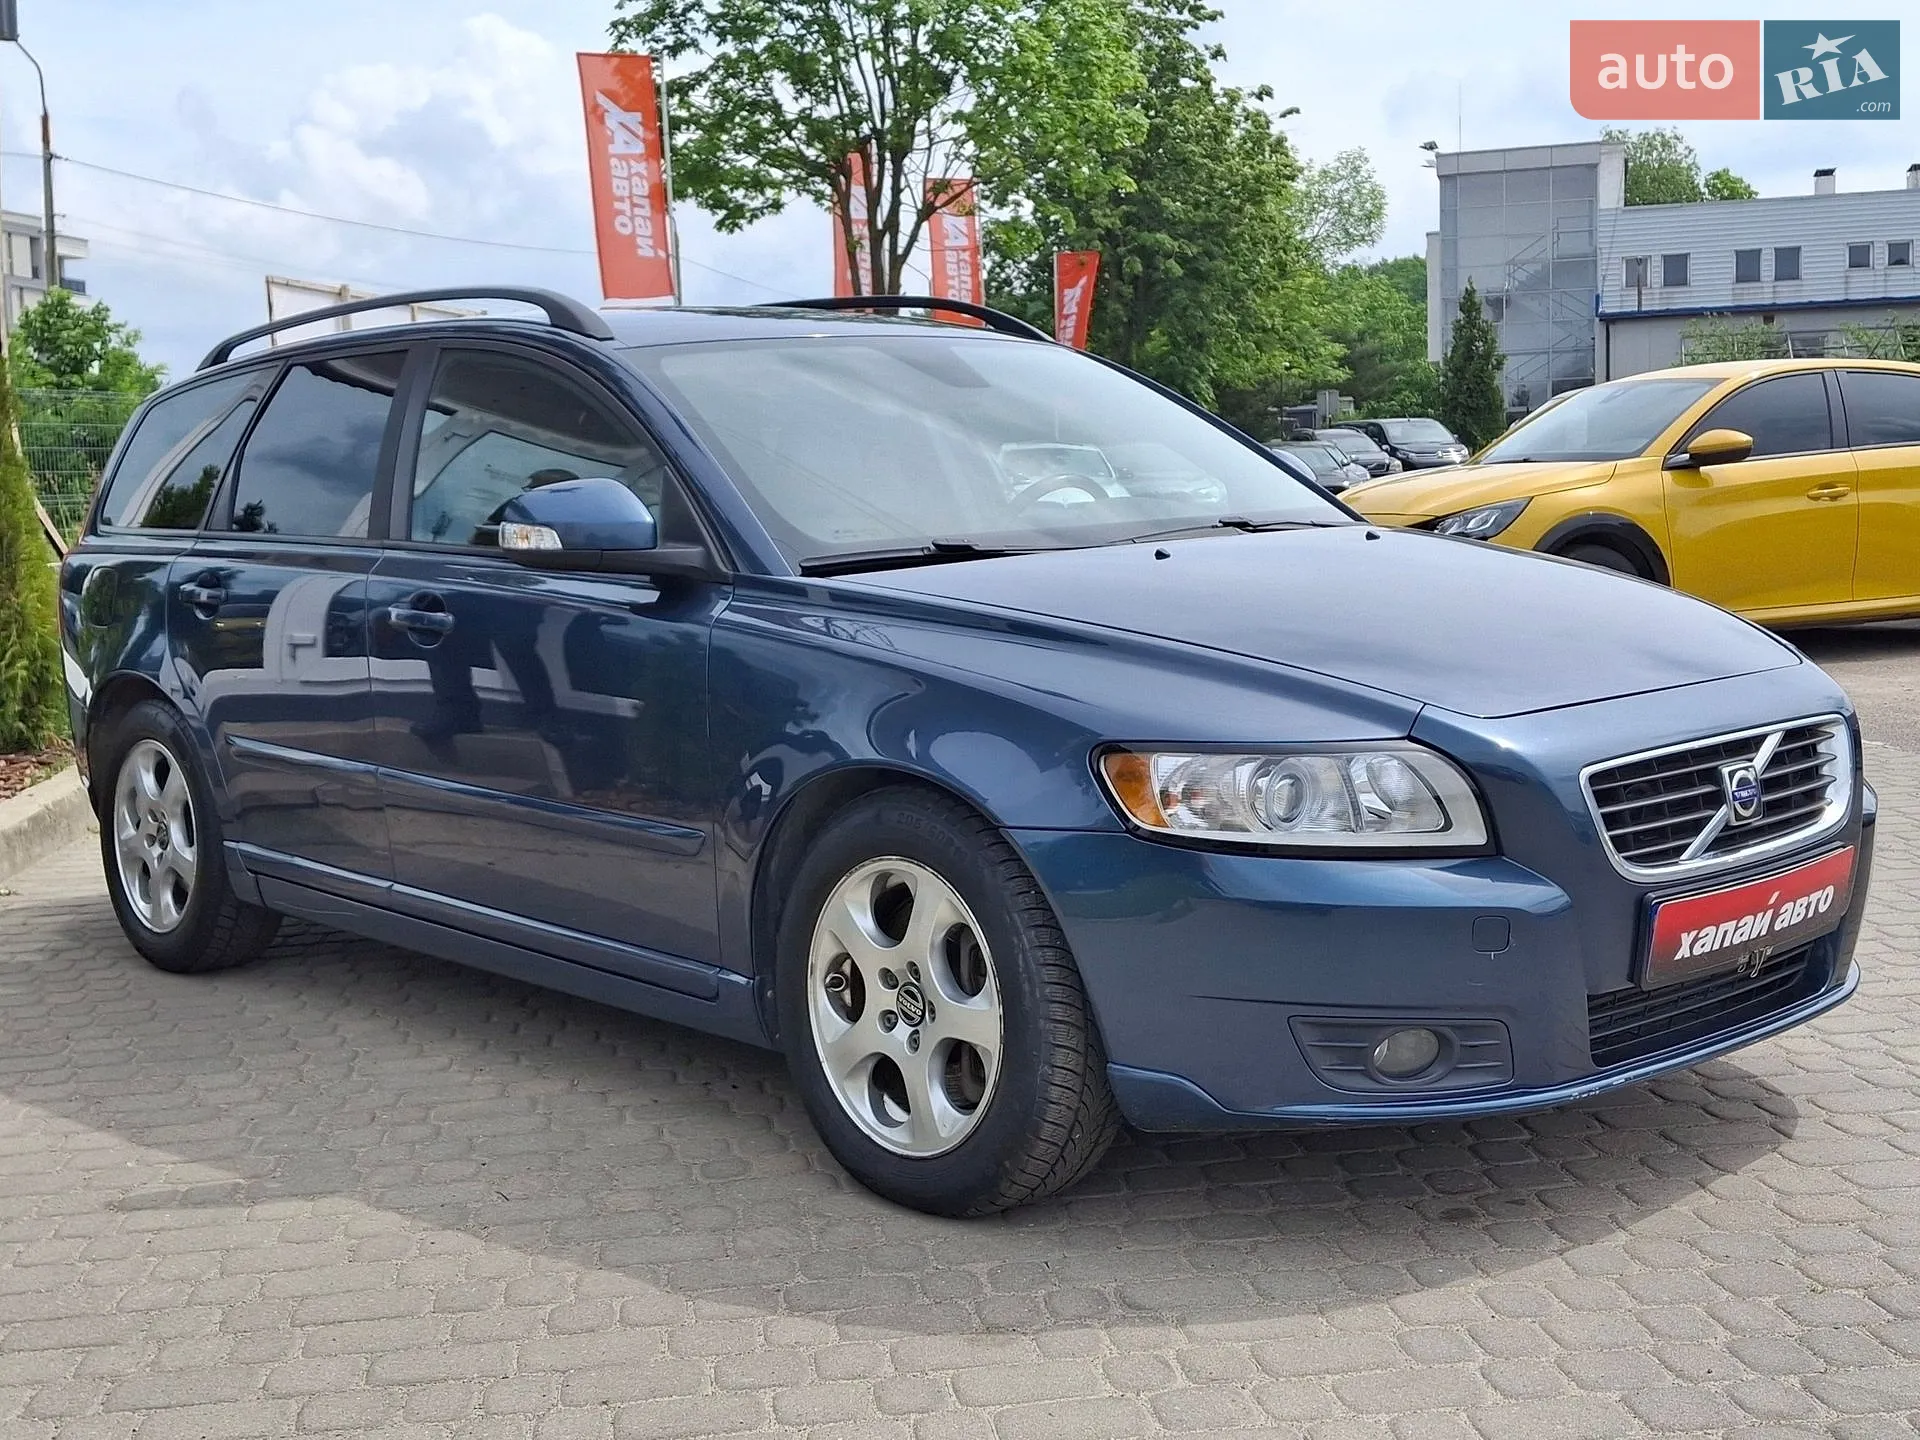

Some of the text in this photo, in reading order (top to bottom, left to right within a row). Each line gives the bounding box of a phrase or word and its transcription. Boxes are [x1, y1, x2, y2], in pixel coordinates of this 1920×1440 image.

[609, 158, 634, 236] авто
[629, 159, 667, 259] хапай
[1674, 885, 1835, 961] хапай авто
[898, 993, 923, 1016] VOLVO
